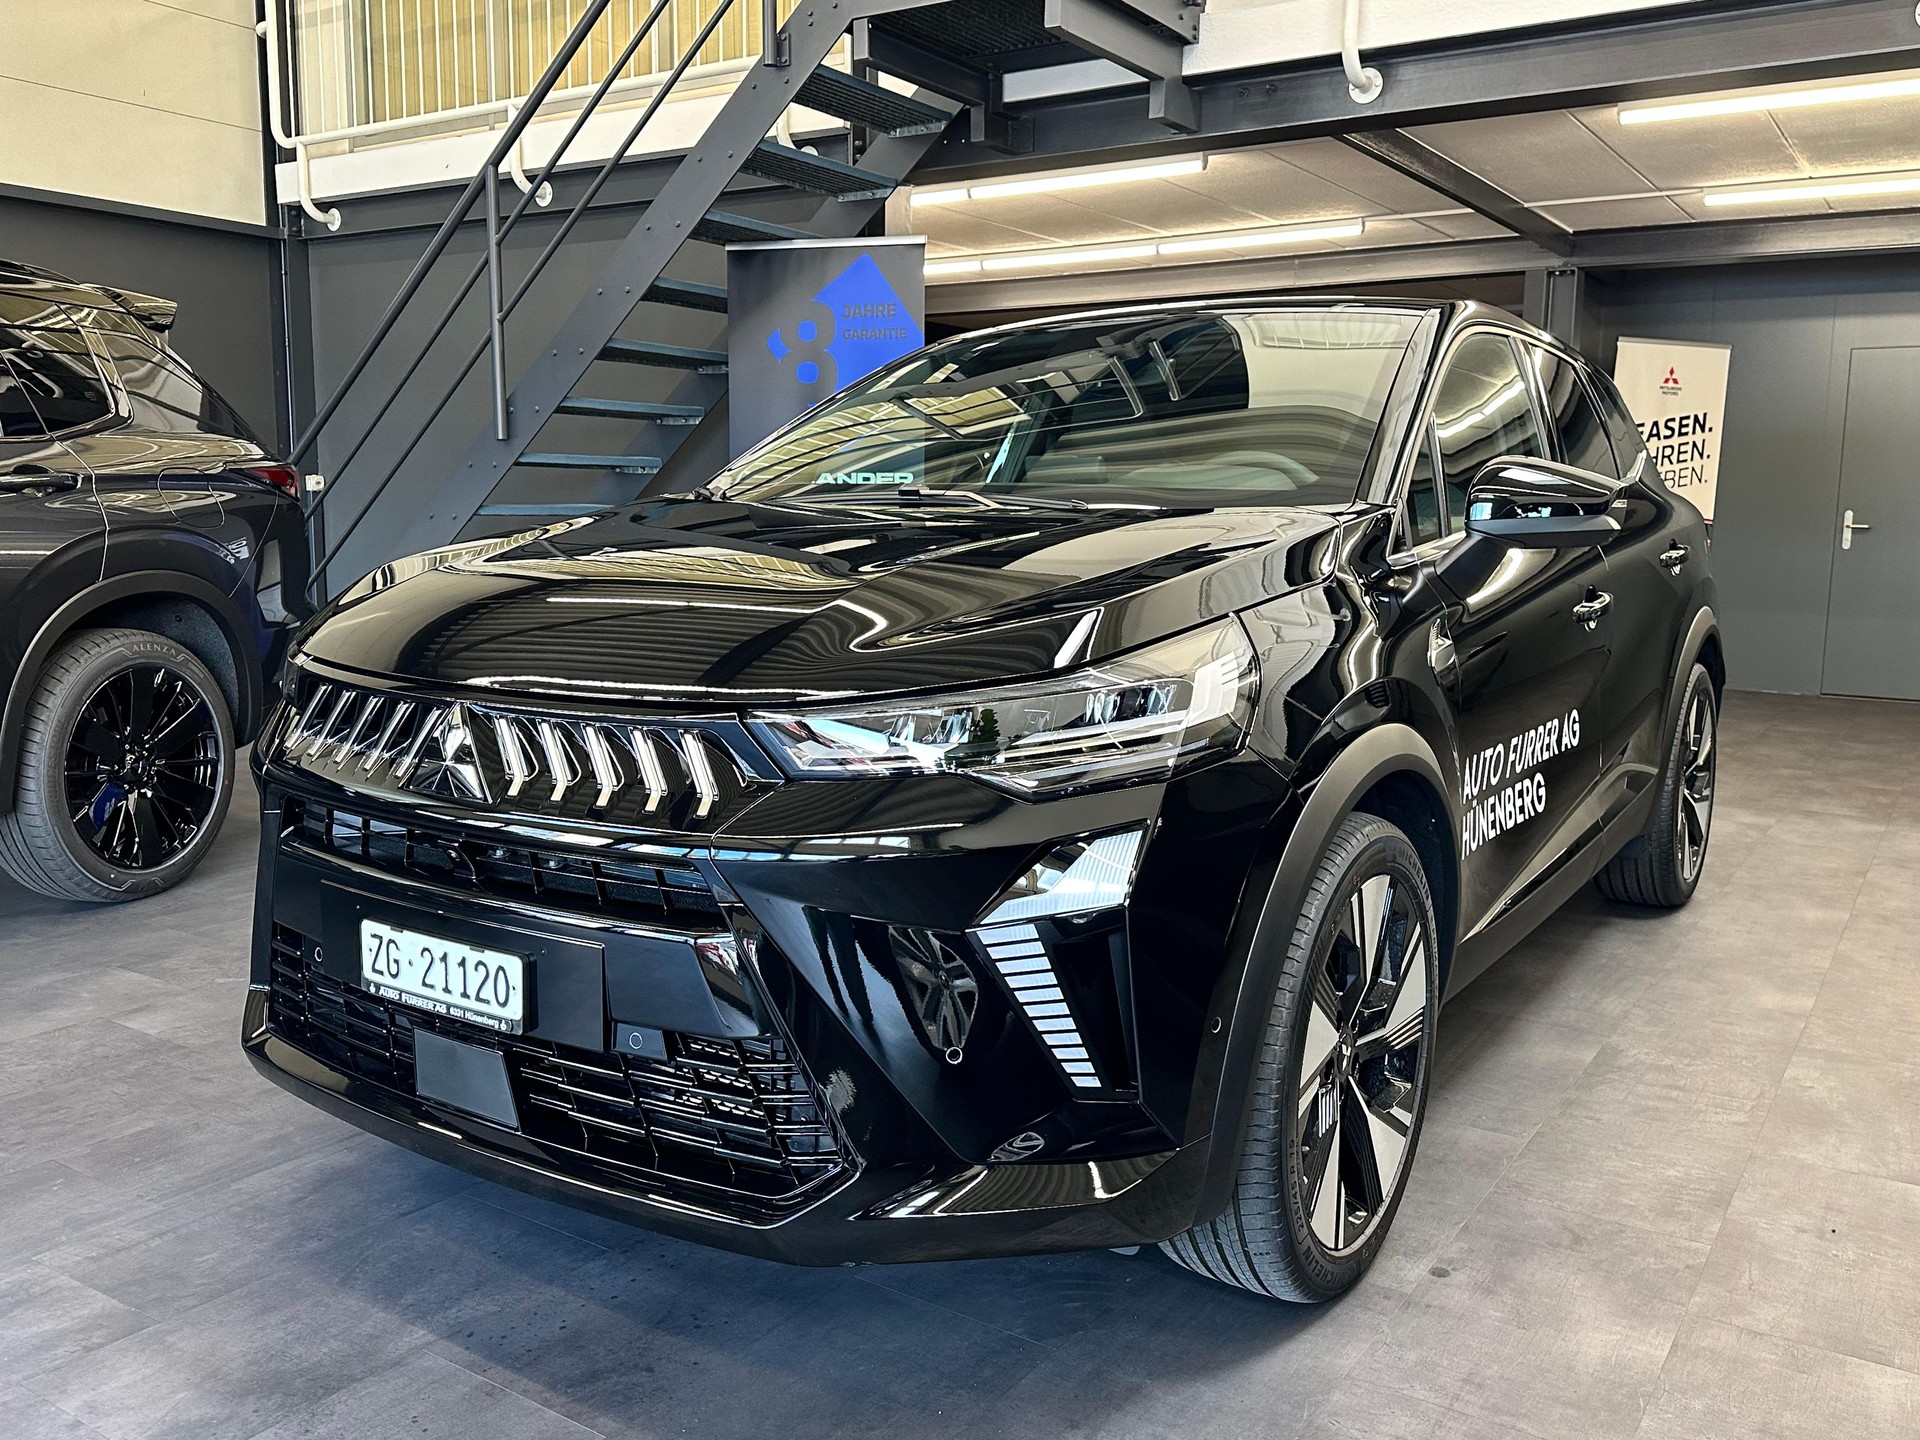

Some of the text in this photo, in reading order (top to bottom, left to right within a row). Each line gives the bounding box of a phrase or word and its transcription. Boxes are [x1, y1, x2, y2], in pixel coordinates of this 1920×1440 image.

[842, 303, 896, 318] JAHRE
[842, 327, 907, 340] GARANTIE
[778, 301, 838, 402] 8
[811, 472, 914, 485] ANDER
[132, 643, 176, 656] ALENZA
[1463, 709, 1580, 804] AUTO FURRER AG
[1462, 772, 1547, 861] HÜNENBERG
[370, 933, 511, 1009] ZG 21120
[379, 985, 400, 1001] AUTO
[401, 991, 435, 1012] FURRER
[435, 1003, 447, 1014] AG
